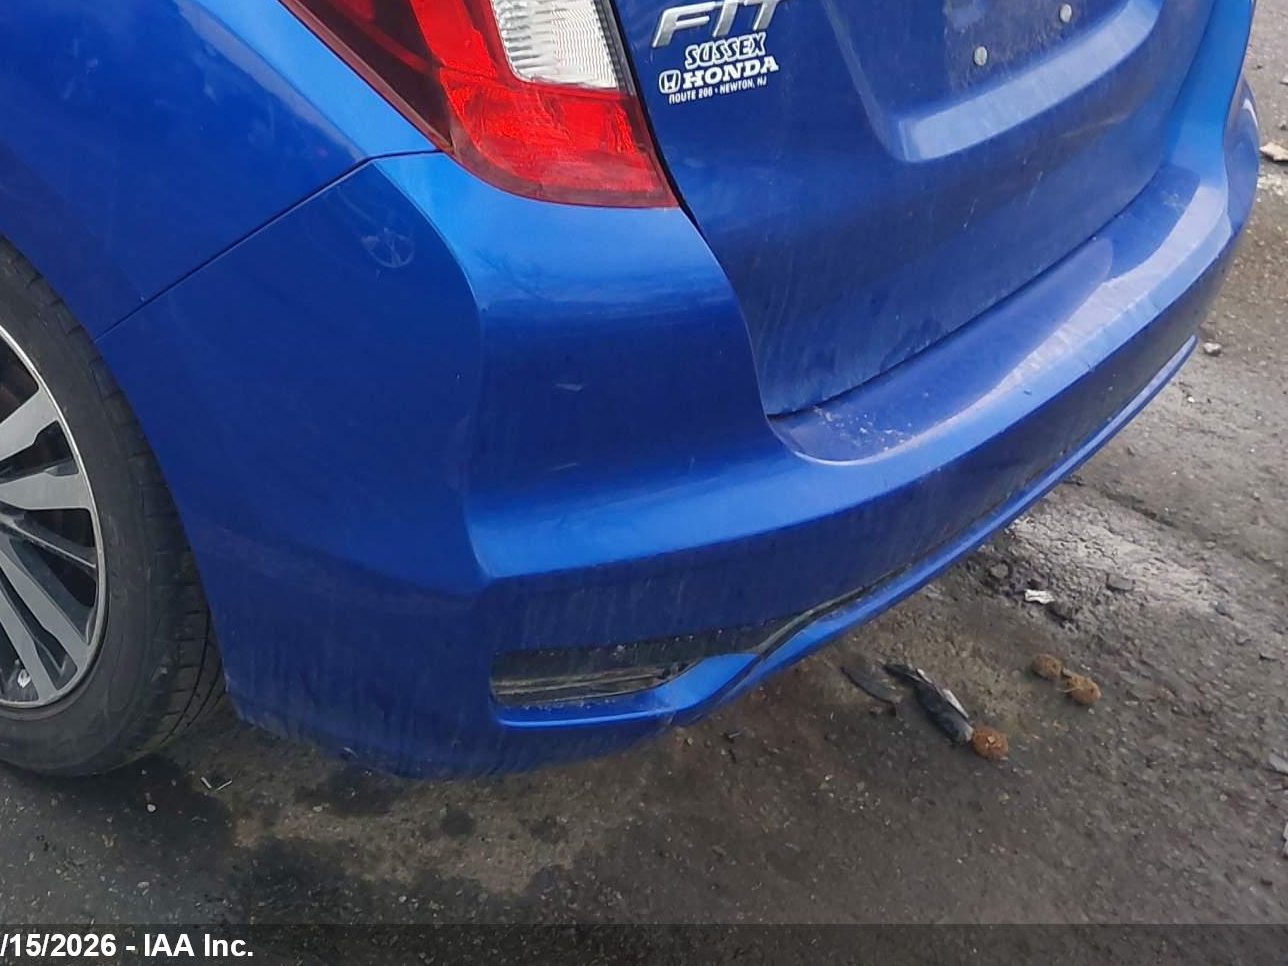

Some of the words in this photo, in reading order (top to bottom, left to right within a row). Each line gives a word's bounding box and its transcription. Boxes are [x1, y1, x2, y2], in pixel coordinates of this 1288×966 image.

[684, 31, 767, 70] SUSSEX
[682, 55, 780, 90] HONDA
[719, 78, 756, 95] NEWTON,
[756, 75, 768, 87] NJ
